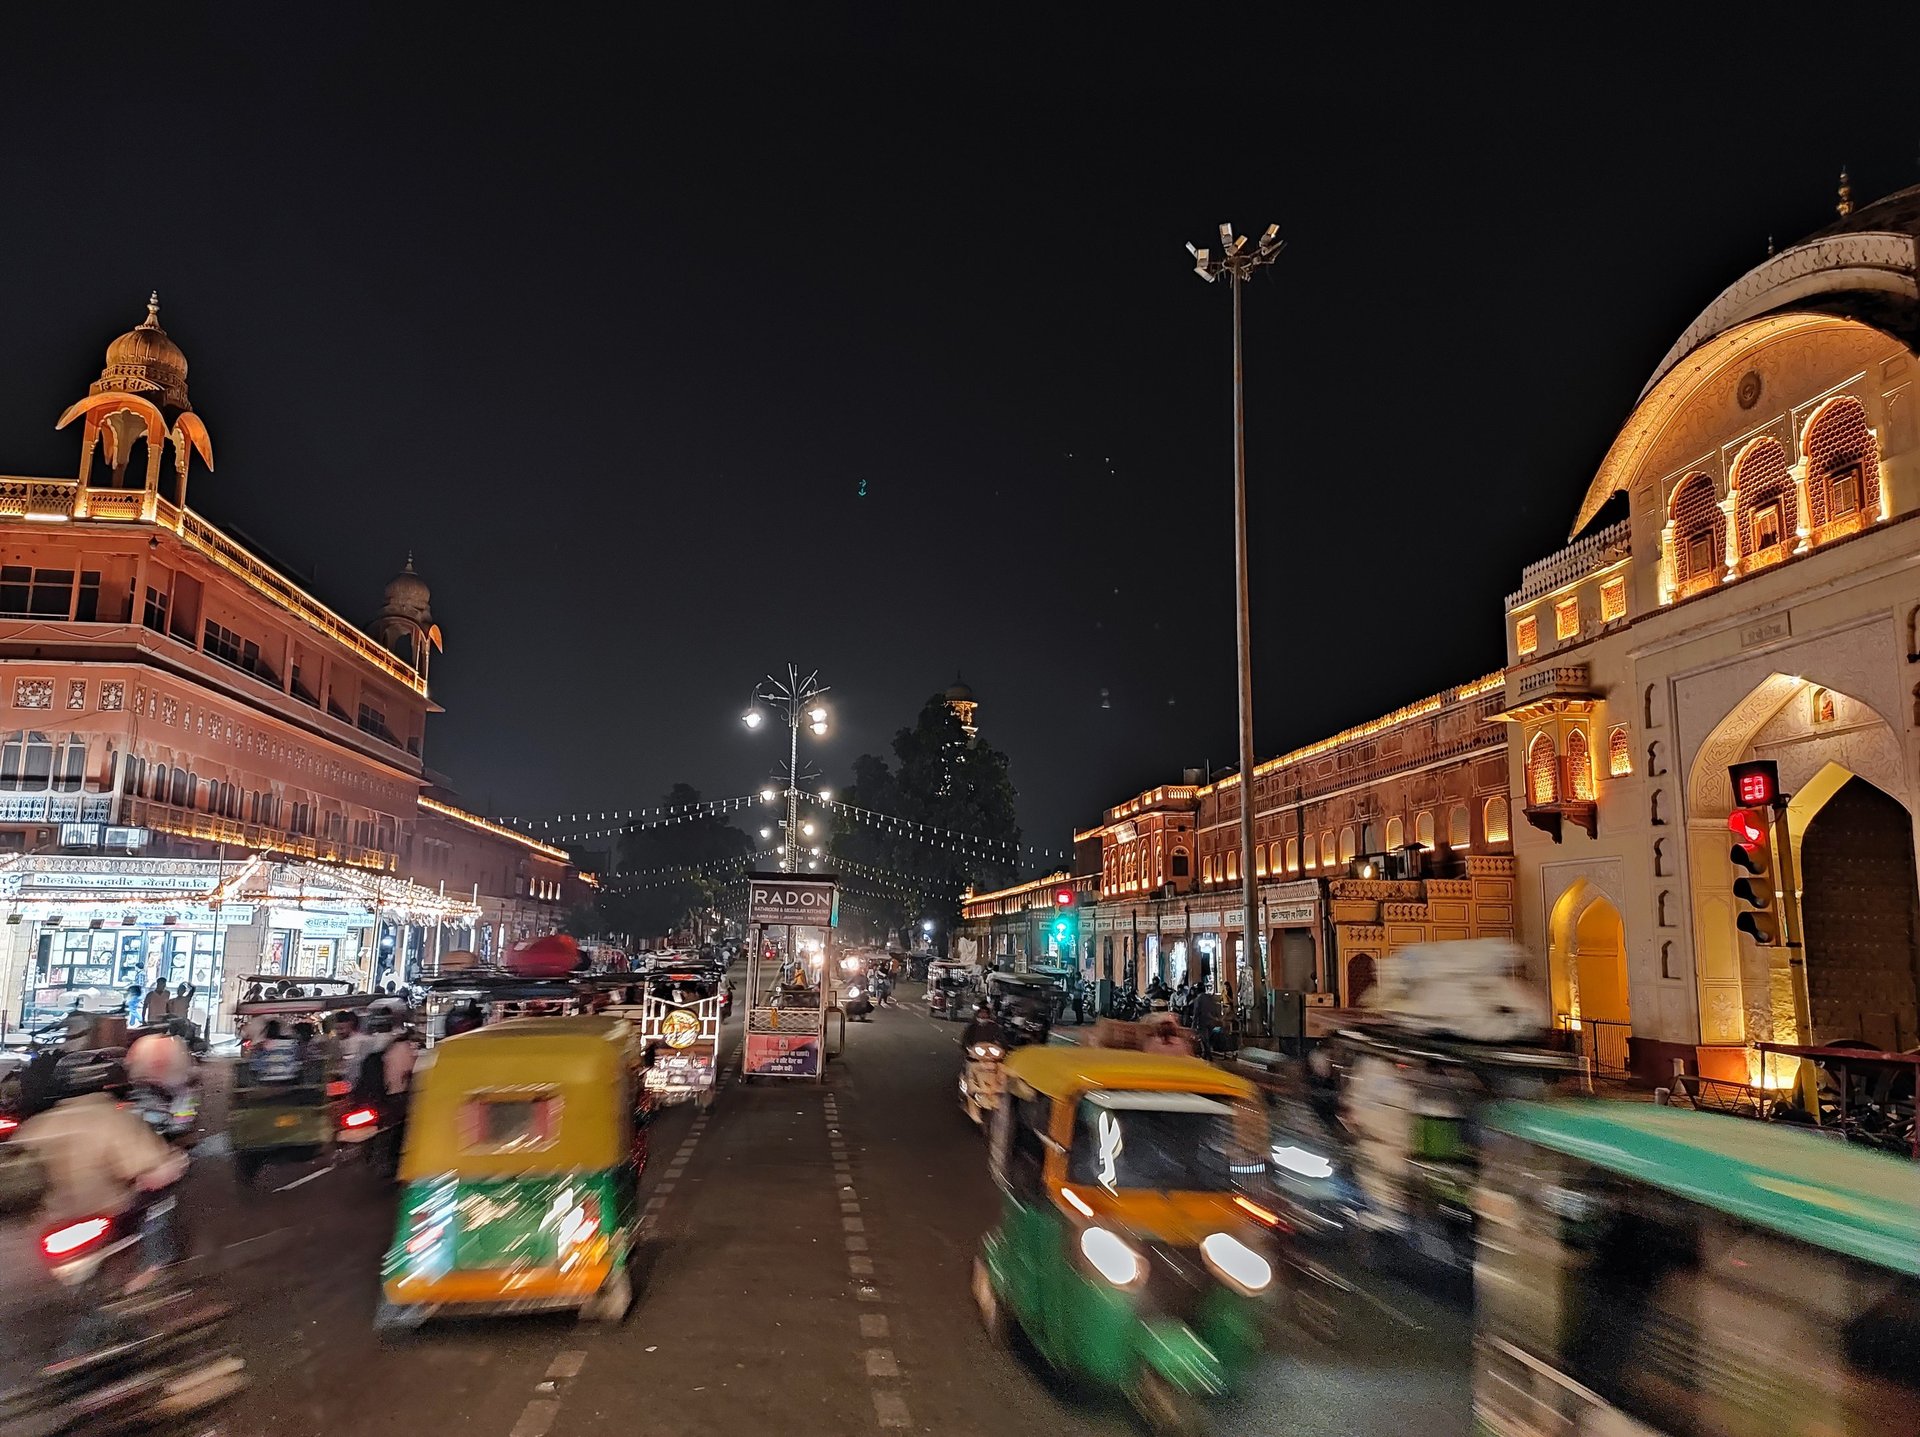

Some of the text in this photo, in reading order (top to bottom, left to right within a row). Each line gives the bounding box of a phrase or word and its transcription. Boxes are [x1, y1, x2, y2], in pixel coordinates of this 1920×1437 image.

[96, 876, 134, 886] महावीर
[755, 890, 830, 906] RADON
[106, 911, 118, 919] 22
